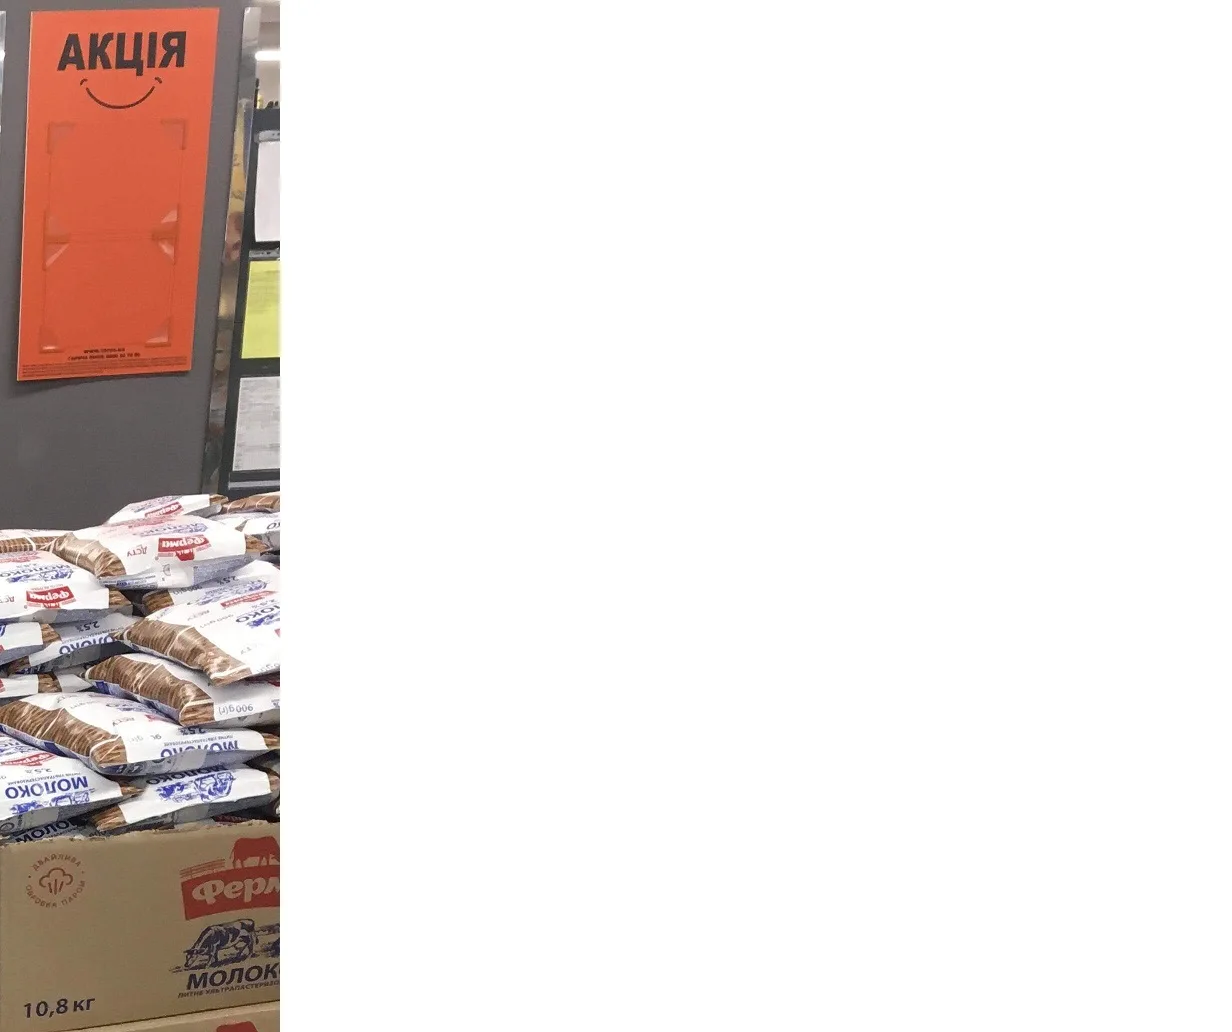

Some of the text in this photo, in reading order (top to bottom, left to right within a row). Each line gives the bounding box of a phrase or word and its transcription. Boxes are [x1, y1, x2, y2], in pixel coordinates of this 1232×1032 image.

[57, 31, 187, 76] АКЦІЯ
[161, 535, 205, 548] Ферма
[29, 589, 70, 601] Ферма
[59, 635, 115, 655] ОЛОКО
[5, 775, 88, 799] МОЛОКО
[15, 820, 71, 843] МОЛО
[191, 876, 280, 904] Ферм
[186, 962, 280, 990] МОЛОК
[205, 980, 280, 995] УЛЬТРАПАСТЕРИЗО
[24, 998, 96, 1019] 10,8 кг
